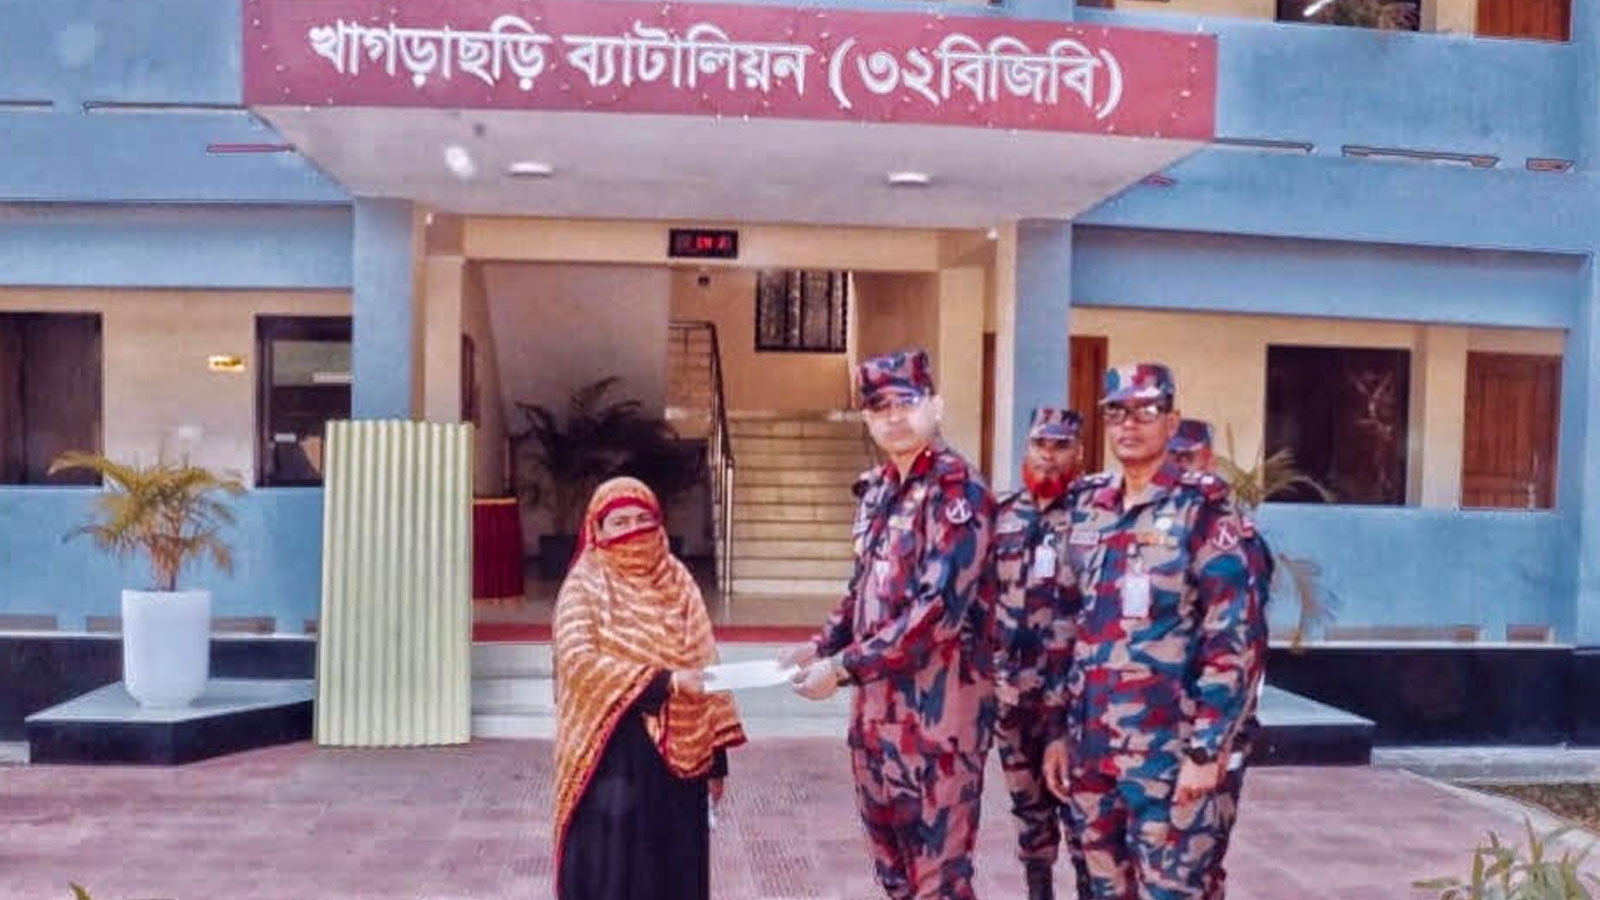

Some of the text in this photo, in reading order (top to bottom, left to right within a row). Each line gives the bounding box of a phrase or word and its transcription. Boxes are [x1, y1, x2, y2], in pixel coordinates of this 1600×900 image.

[308, 15, 1123, 119] খাগড়াছড়ি ব্যাটালিয়ন (৩২বিজিবি)
